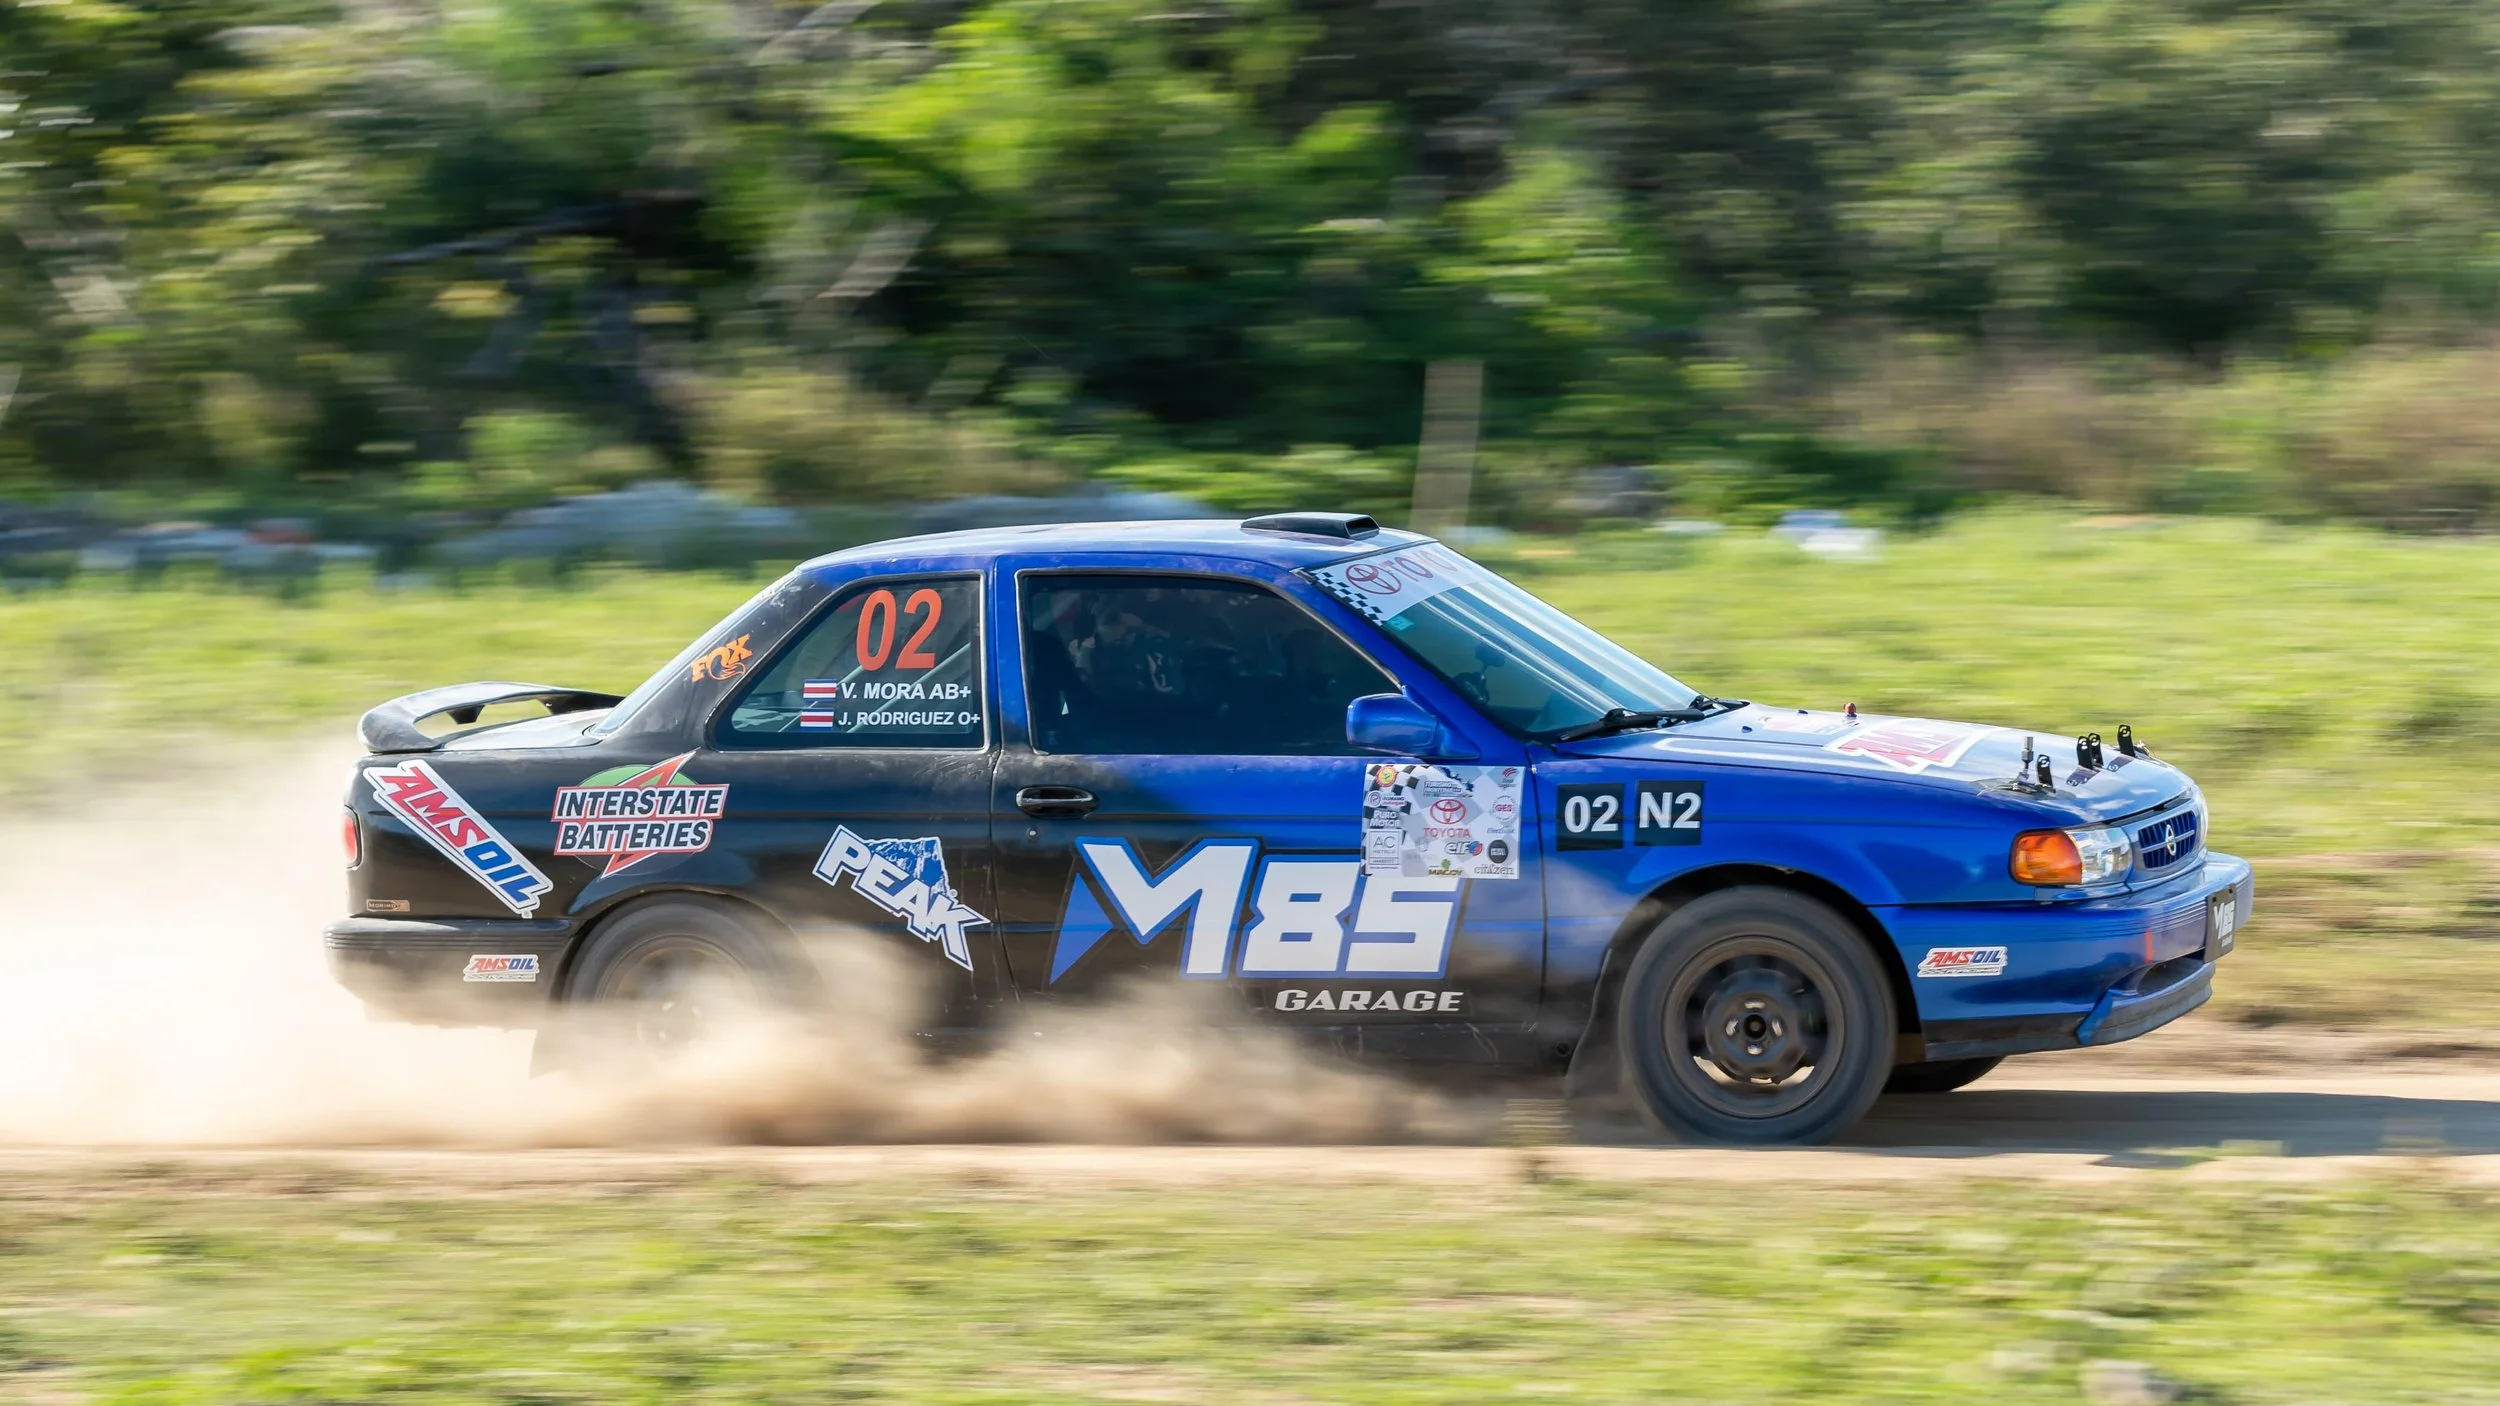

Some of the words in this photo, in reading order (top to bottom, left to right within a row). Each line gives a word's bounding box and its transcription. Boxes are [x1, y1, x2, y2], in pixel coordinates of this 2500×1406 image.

[856, 588, 942, 671] 02
[691, 634, 753, 682] FOX
[841, 683, 858, 699] V.
[864, 683, 925, 699] MORA
[928, 683, 972, 699] AB+
[838, 711, 851, 726] J.
[857, 711, 953, 726] RODRIGUEZ
[557, 789, 722, 816] INTERSTATE
[1564, 795, 1619, 833] 02
[1639, 792, 1701, 828] N2
[379, 766, 541, 903] AMSOIL
[560, 821, 709, 849] BATTERIES
[1373, 836, 1396, 848] AC
[1423, 827, 1471, 838] TOYOTA
[816, 828, 984, 965] PEAK
[1056, 837, 1464, 979] M85
[470, 958, 535, 973] AMSOIL
[1926, 951, 2001, 967] AMSOIL
[1274, 989, 1465, 1011] GARAGE
